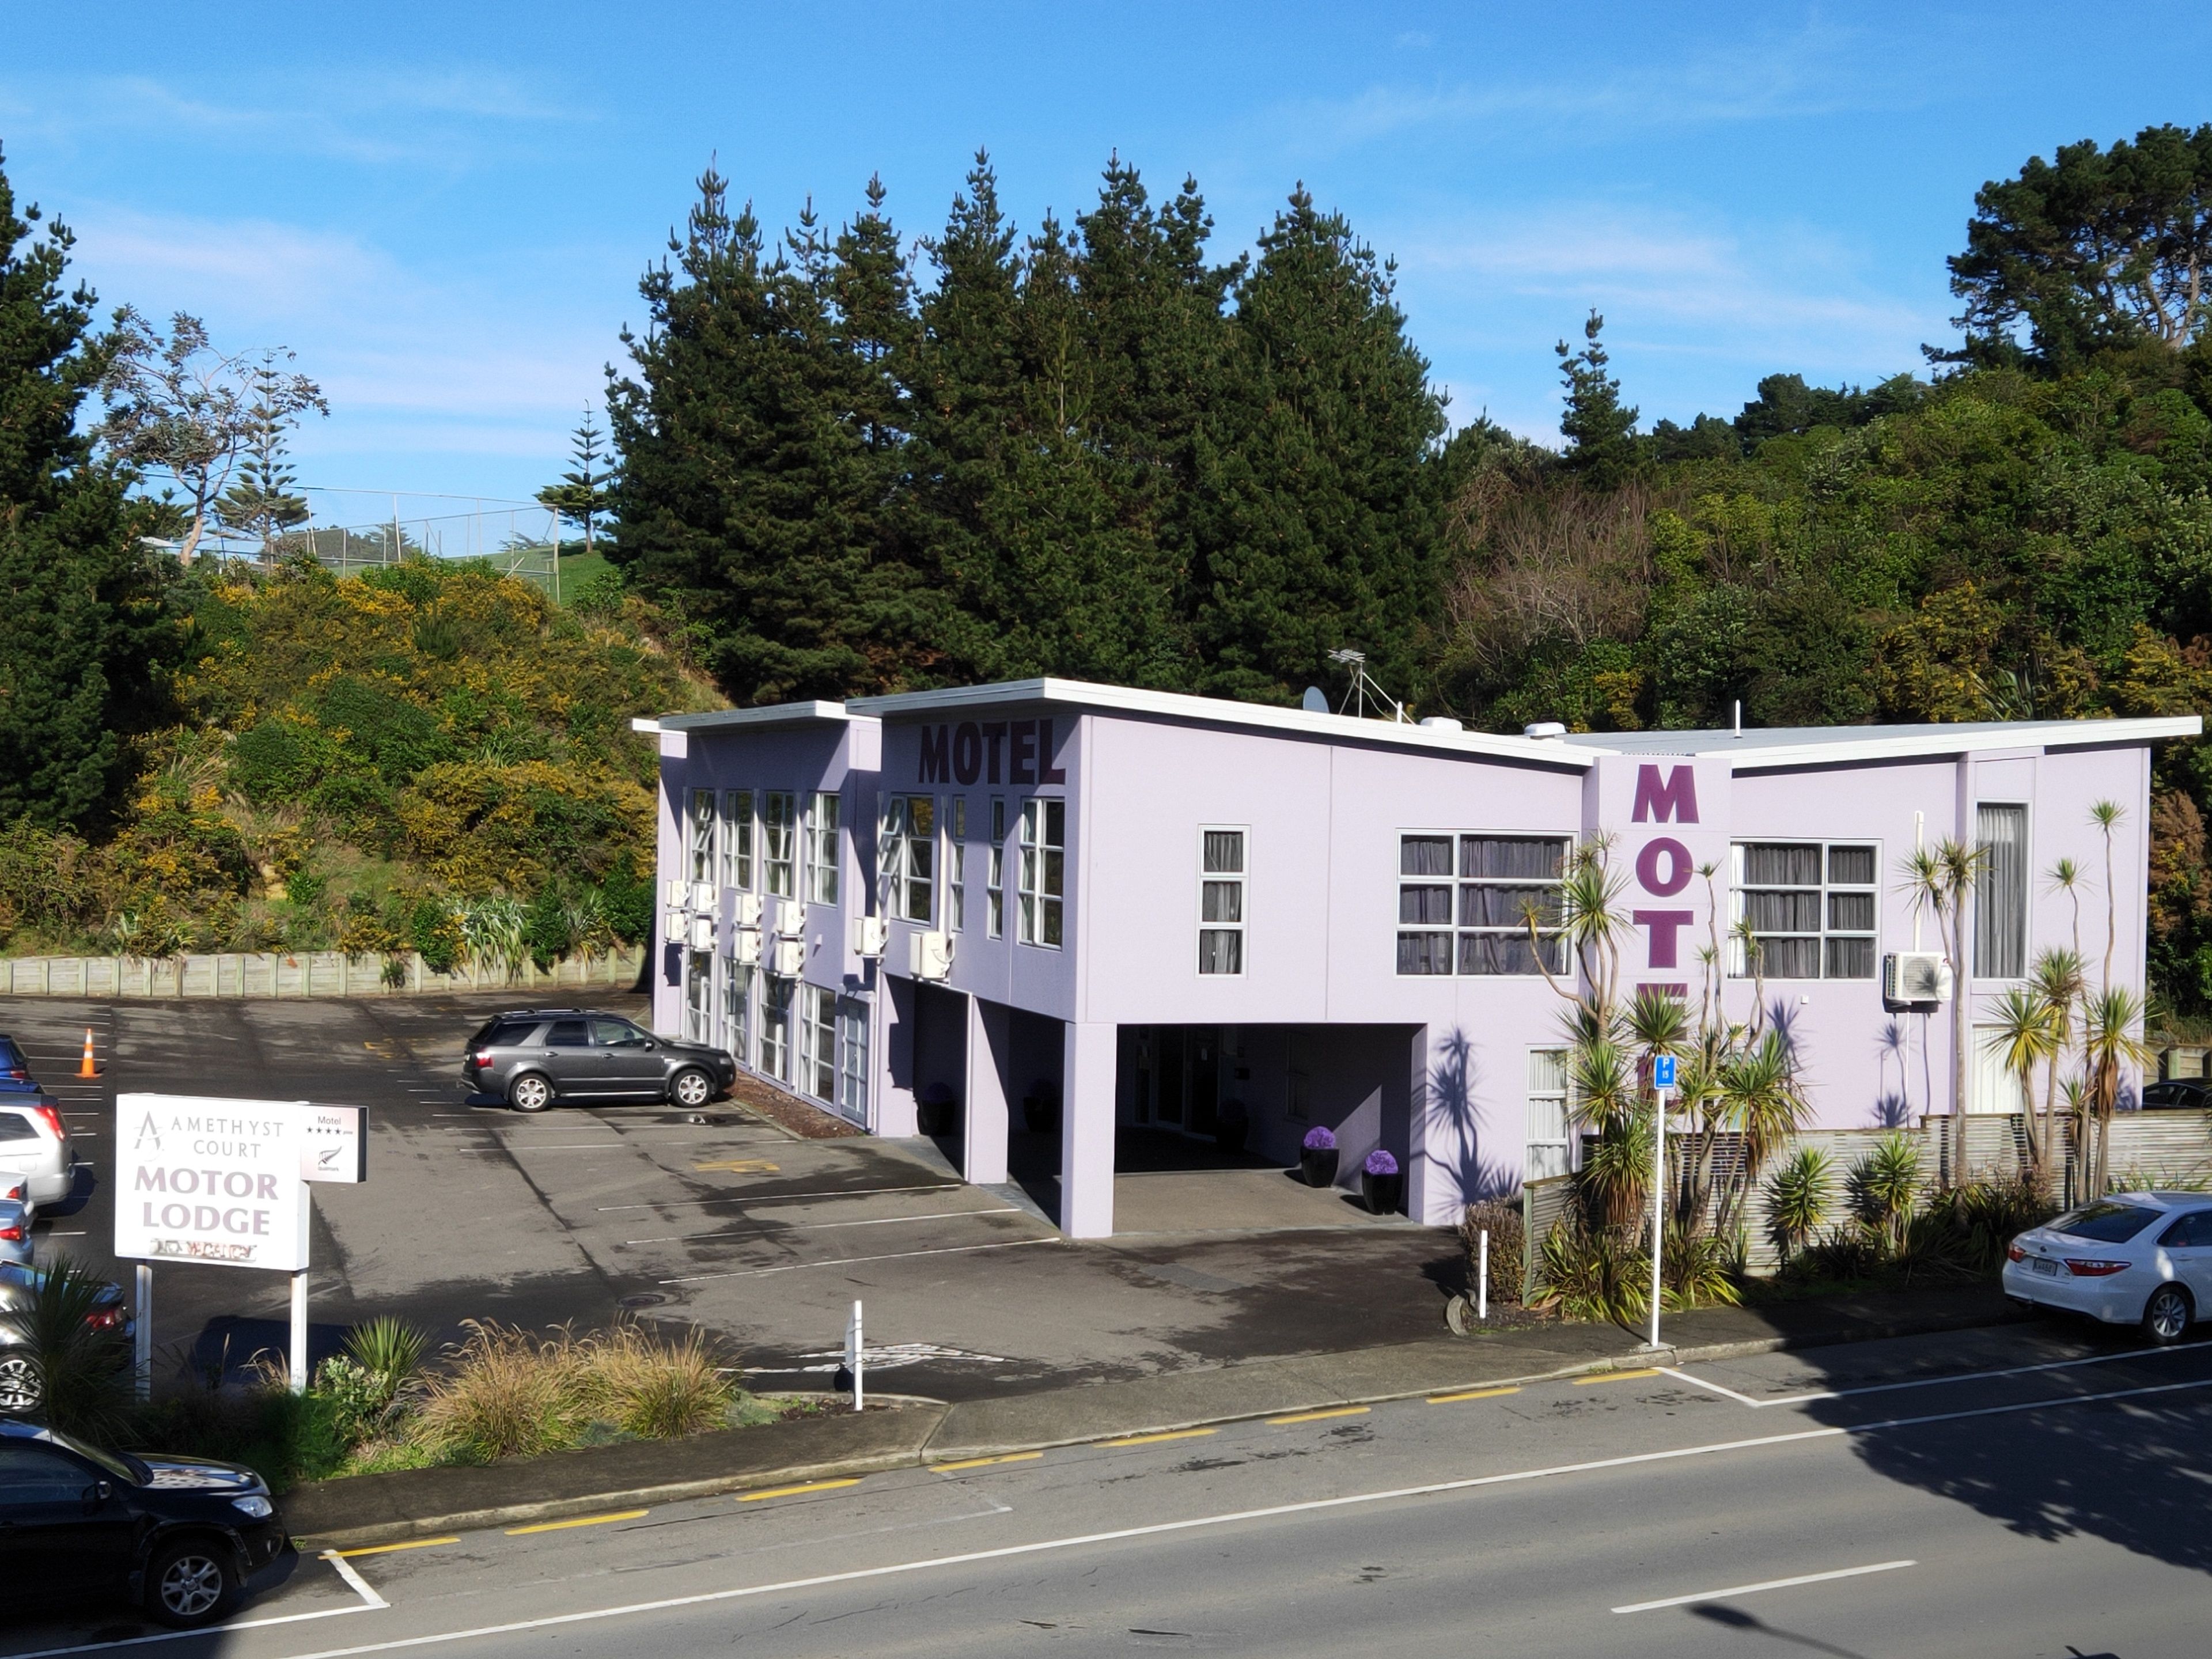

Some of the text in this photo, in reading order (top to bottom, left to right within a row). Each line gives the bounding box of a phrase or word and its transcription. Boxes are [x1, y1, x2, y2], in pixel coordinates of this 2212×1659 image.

[918, 719, 1066, 786] MOTEL
[1663, 1057, 1670, 1069] P
[171, 1116, 285, 1137] AMETHYST
[317, 1115, 342, 1125] Motel
[193, 1139, 262, 1158] COURT
[134, 1165, 279, 1200] MOTOR
[143, 1202, 270, 1236] LODGE
